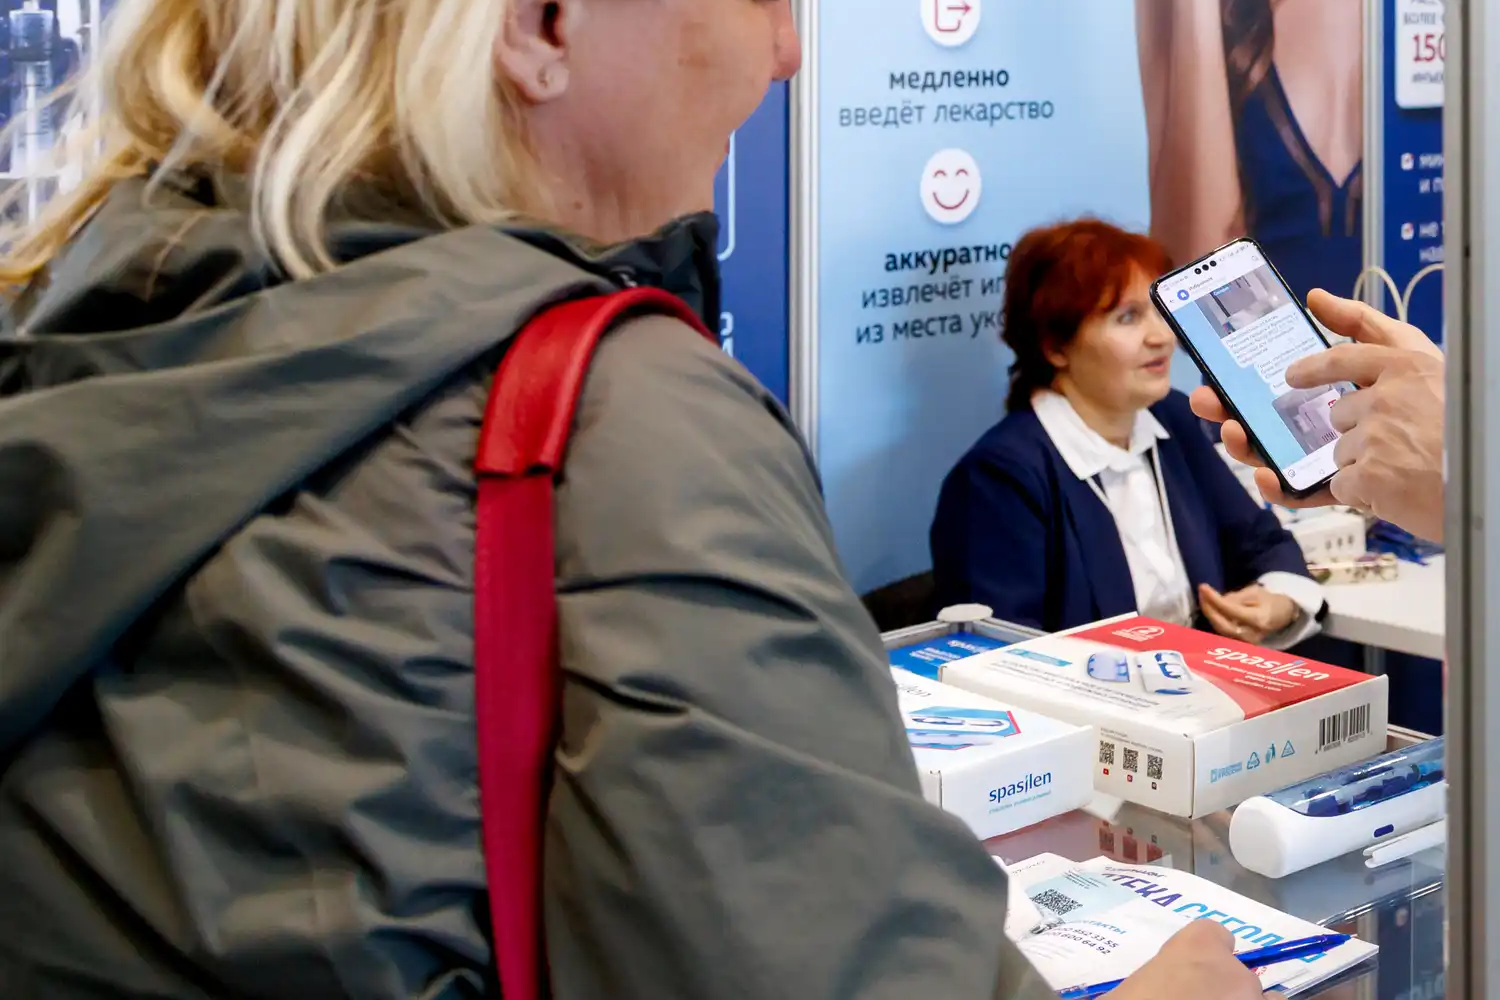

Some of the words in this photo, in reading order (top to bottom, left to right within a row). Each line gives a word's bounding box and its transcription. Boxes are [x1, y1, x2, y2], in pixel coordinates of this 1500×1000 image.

[888, 67, 1010, 94] медленно
[838, 100, 925, 129] введёт
[933, 99, 1055, 128] лекарство
[861, 274, 974, 310] извлечёт
[856, 323, 884, 344] из
[892, 313, 963, 341] места
[988, 771, 1052, 804] spasilen
